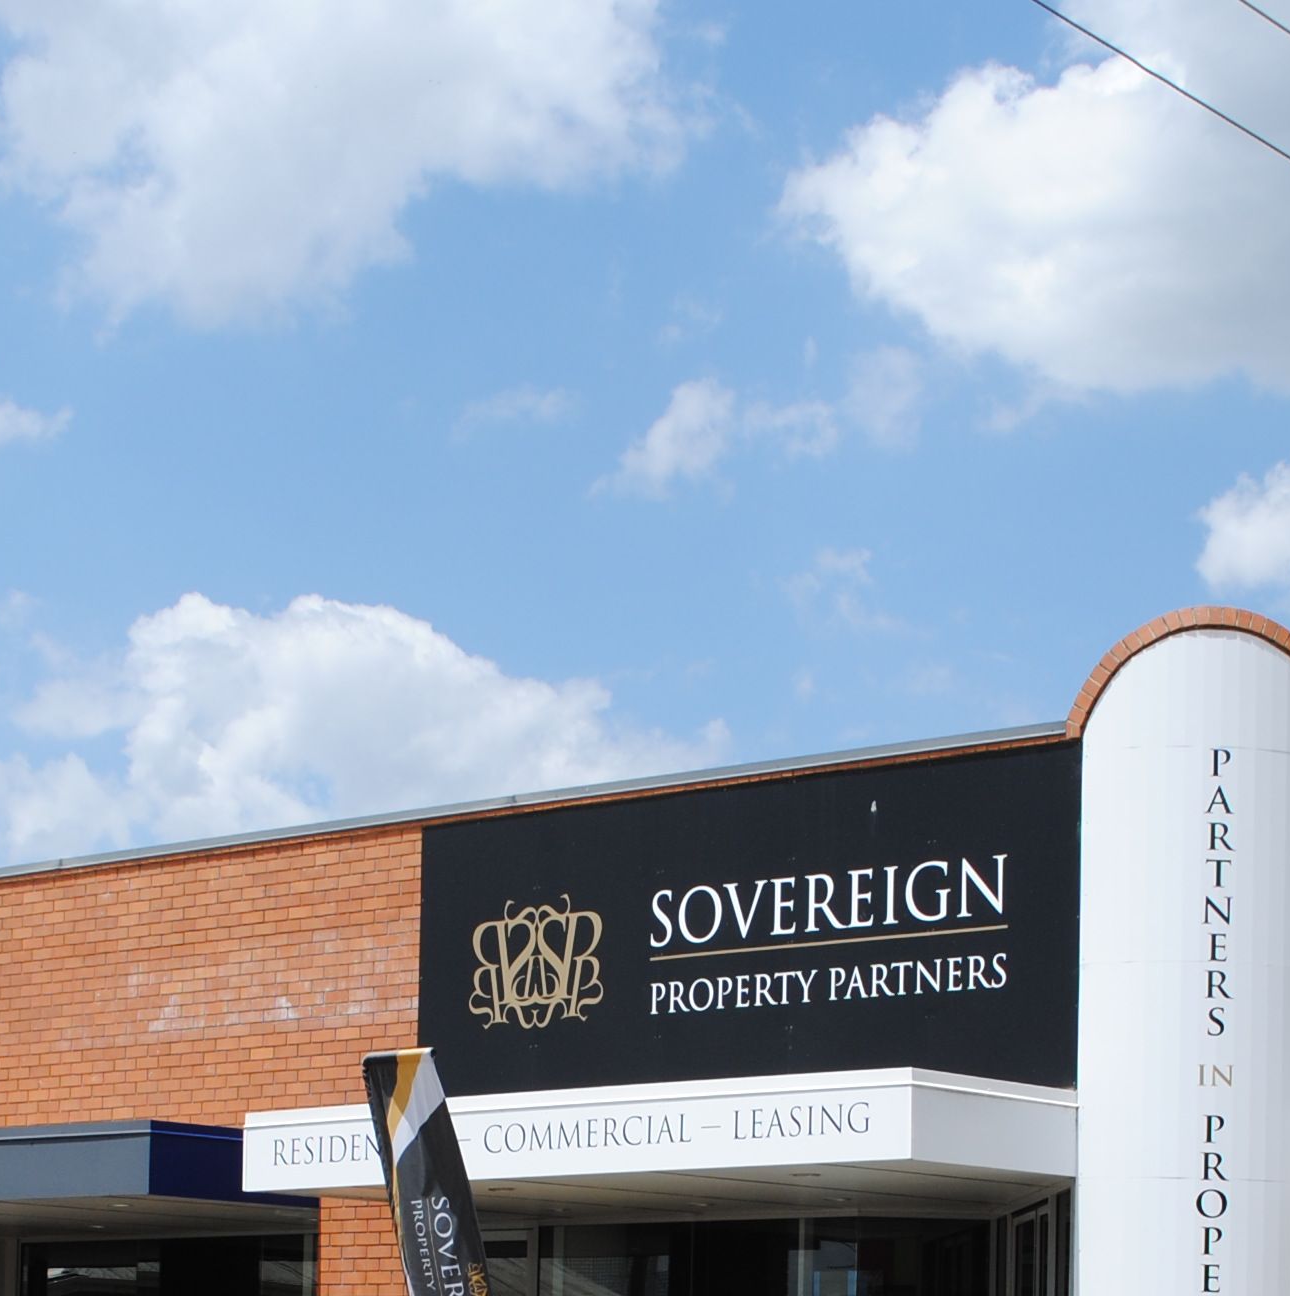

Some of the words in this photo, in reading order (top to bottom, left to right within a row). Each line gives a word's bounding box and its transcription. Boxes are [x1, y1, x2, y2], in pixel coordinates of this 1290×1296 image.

[650, 854, 1009, 949] SOVEREIGN
[1200, 747, 1235, 1037] PARTNERS
[650, 968, 818, 1015] PROPERTY
[828, 953, 1009, 1002] PARTNERS
[1197, 1064, 1234, 1087] IN
[482, 1111, 692, 1154] COMMERCIAL
[732, 1101, 872, 1140] LEASING
[410, 1199, 438, 1293] PROPERTY
